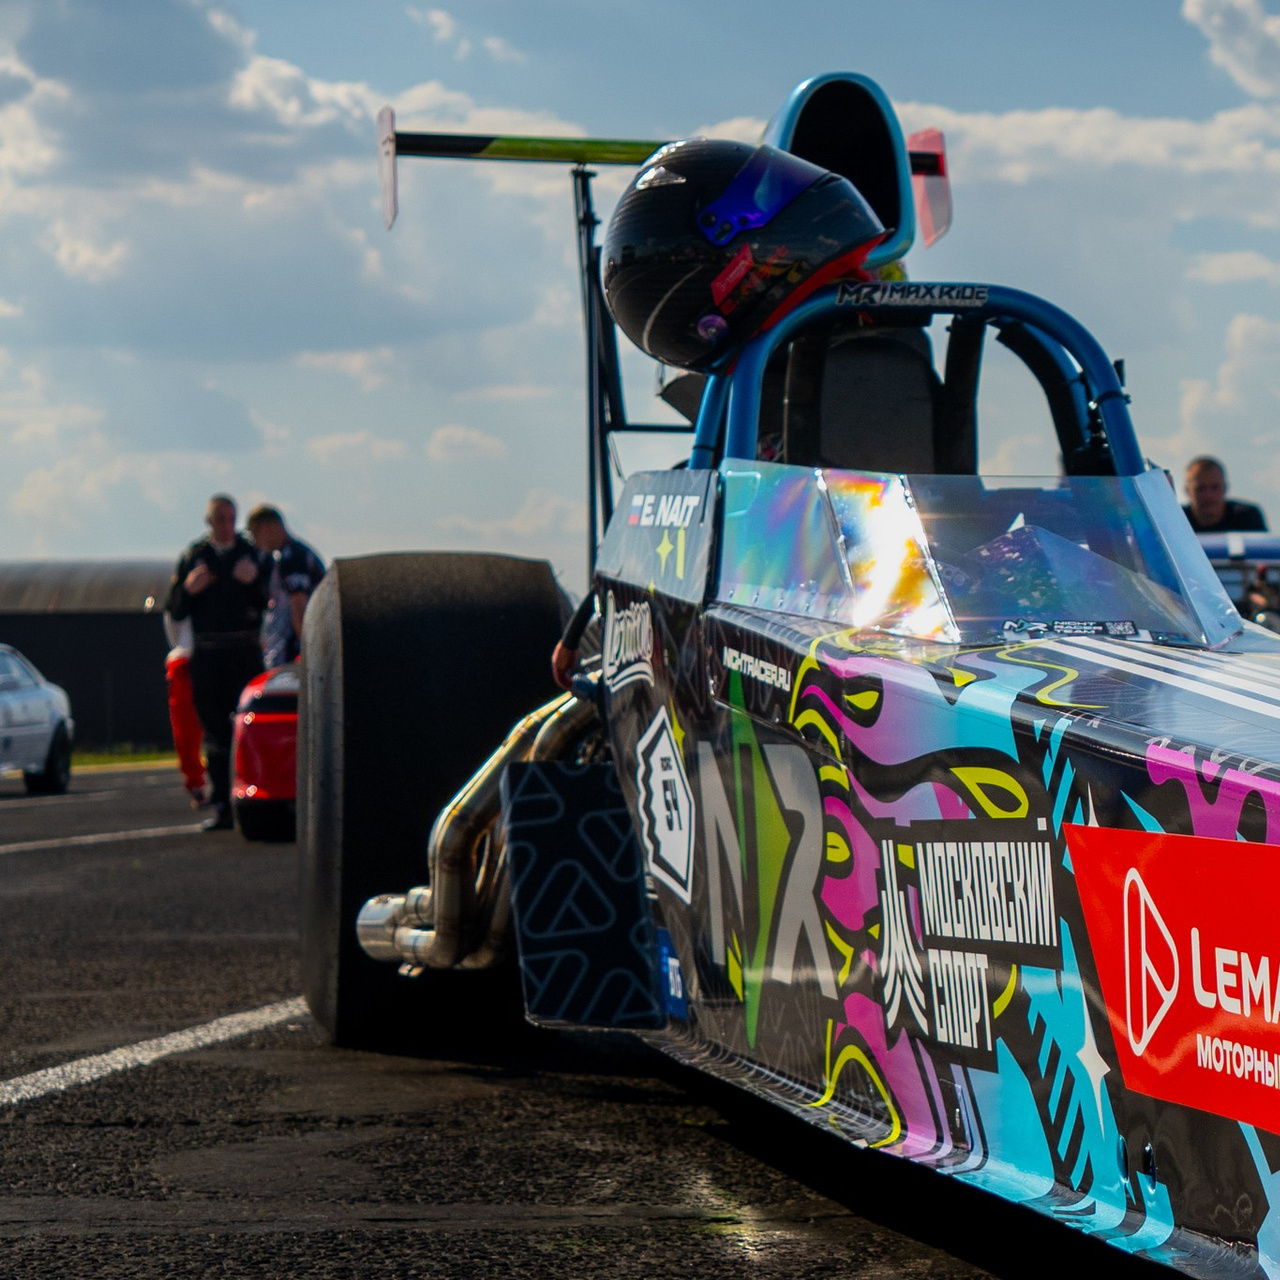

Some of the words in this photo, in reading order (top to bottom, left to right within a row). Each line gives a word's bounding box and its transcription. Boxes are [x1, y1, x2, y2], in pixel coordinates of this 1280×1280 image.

[655, 494, 700, 527] NAIT
[916, 817, 1057, 946] МОСКОВСКИЙ
[928, 948, 993, 1051] СПОРТ
